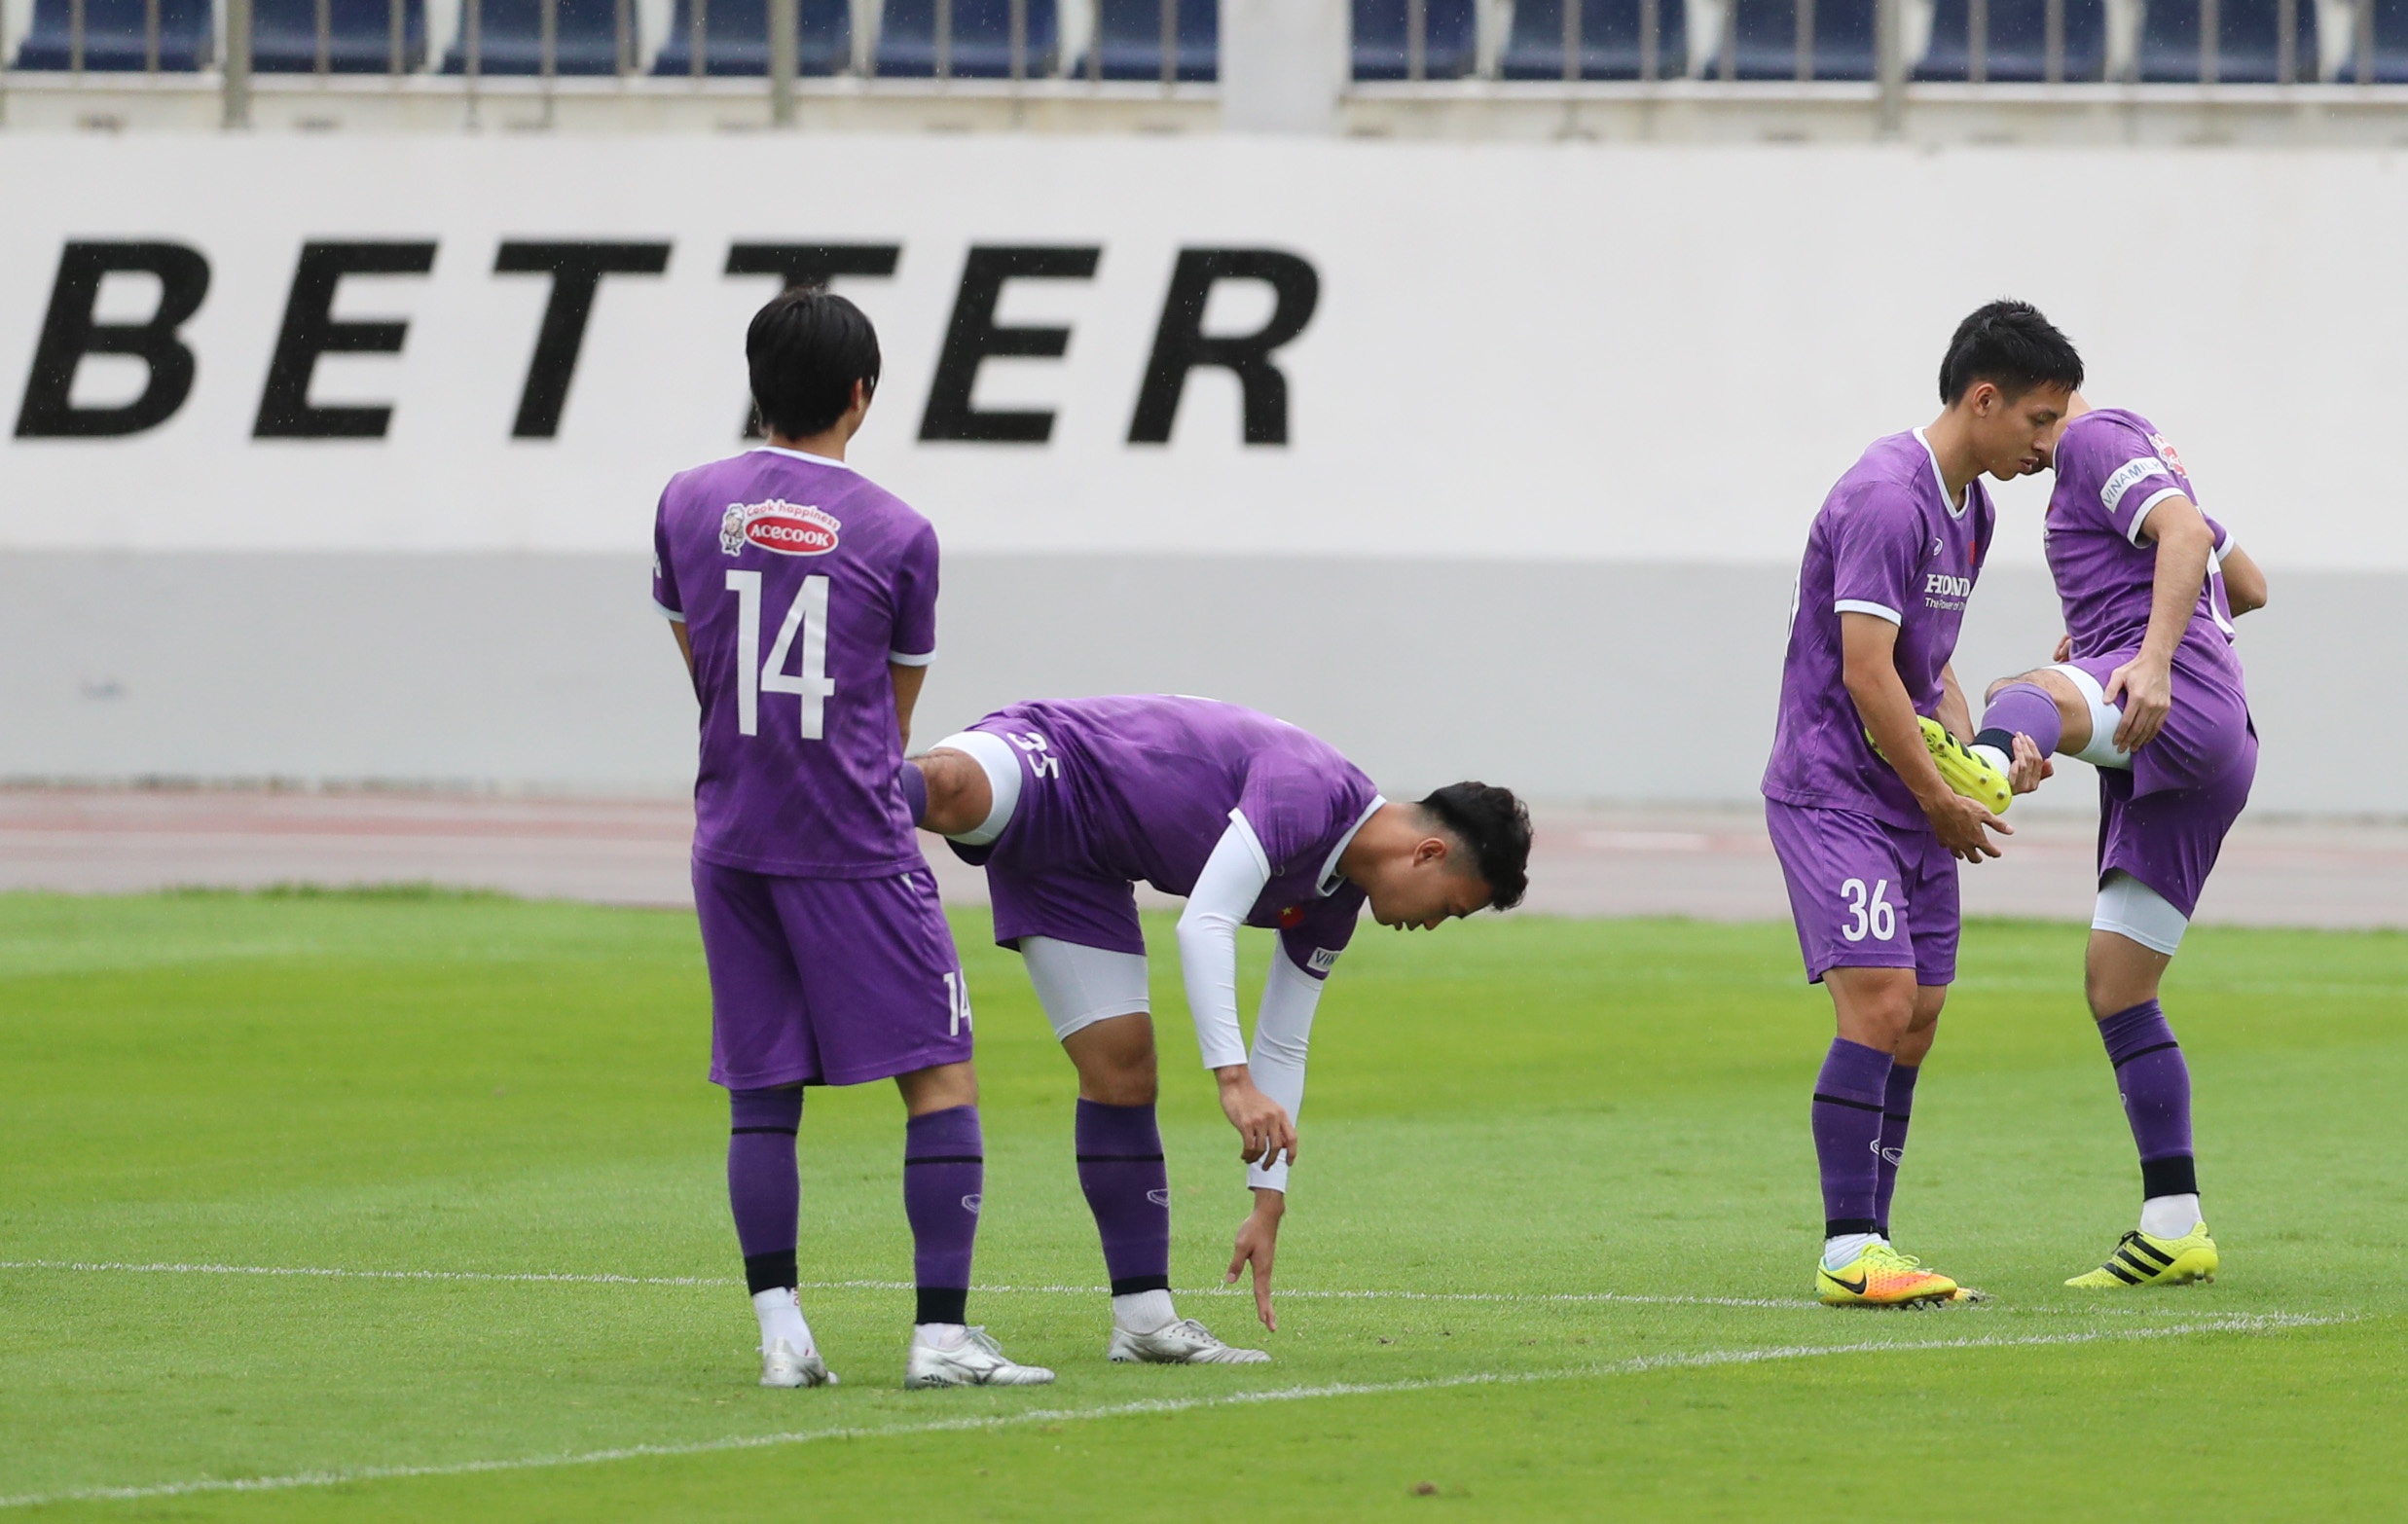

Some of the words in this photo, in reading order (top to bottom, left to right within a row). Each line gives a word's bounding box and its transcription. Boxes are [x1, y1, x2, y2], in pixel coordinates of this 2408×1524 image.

[12, 239, 1322, 448] BETTER
[2102, 461, 2161, 505] VINAMILK
[747, 503, 775, 517] Cook
[779, 504, 839, 529] happiness
[1924, 573, 1971, 598] HOND
[725, 569, 835, 741] 14
[1006, 732, 1060, 780] 35
[1841, 878, 1896, 942] 36
[943, 968, 973, 1036] 14
